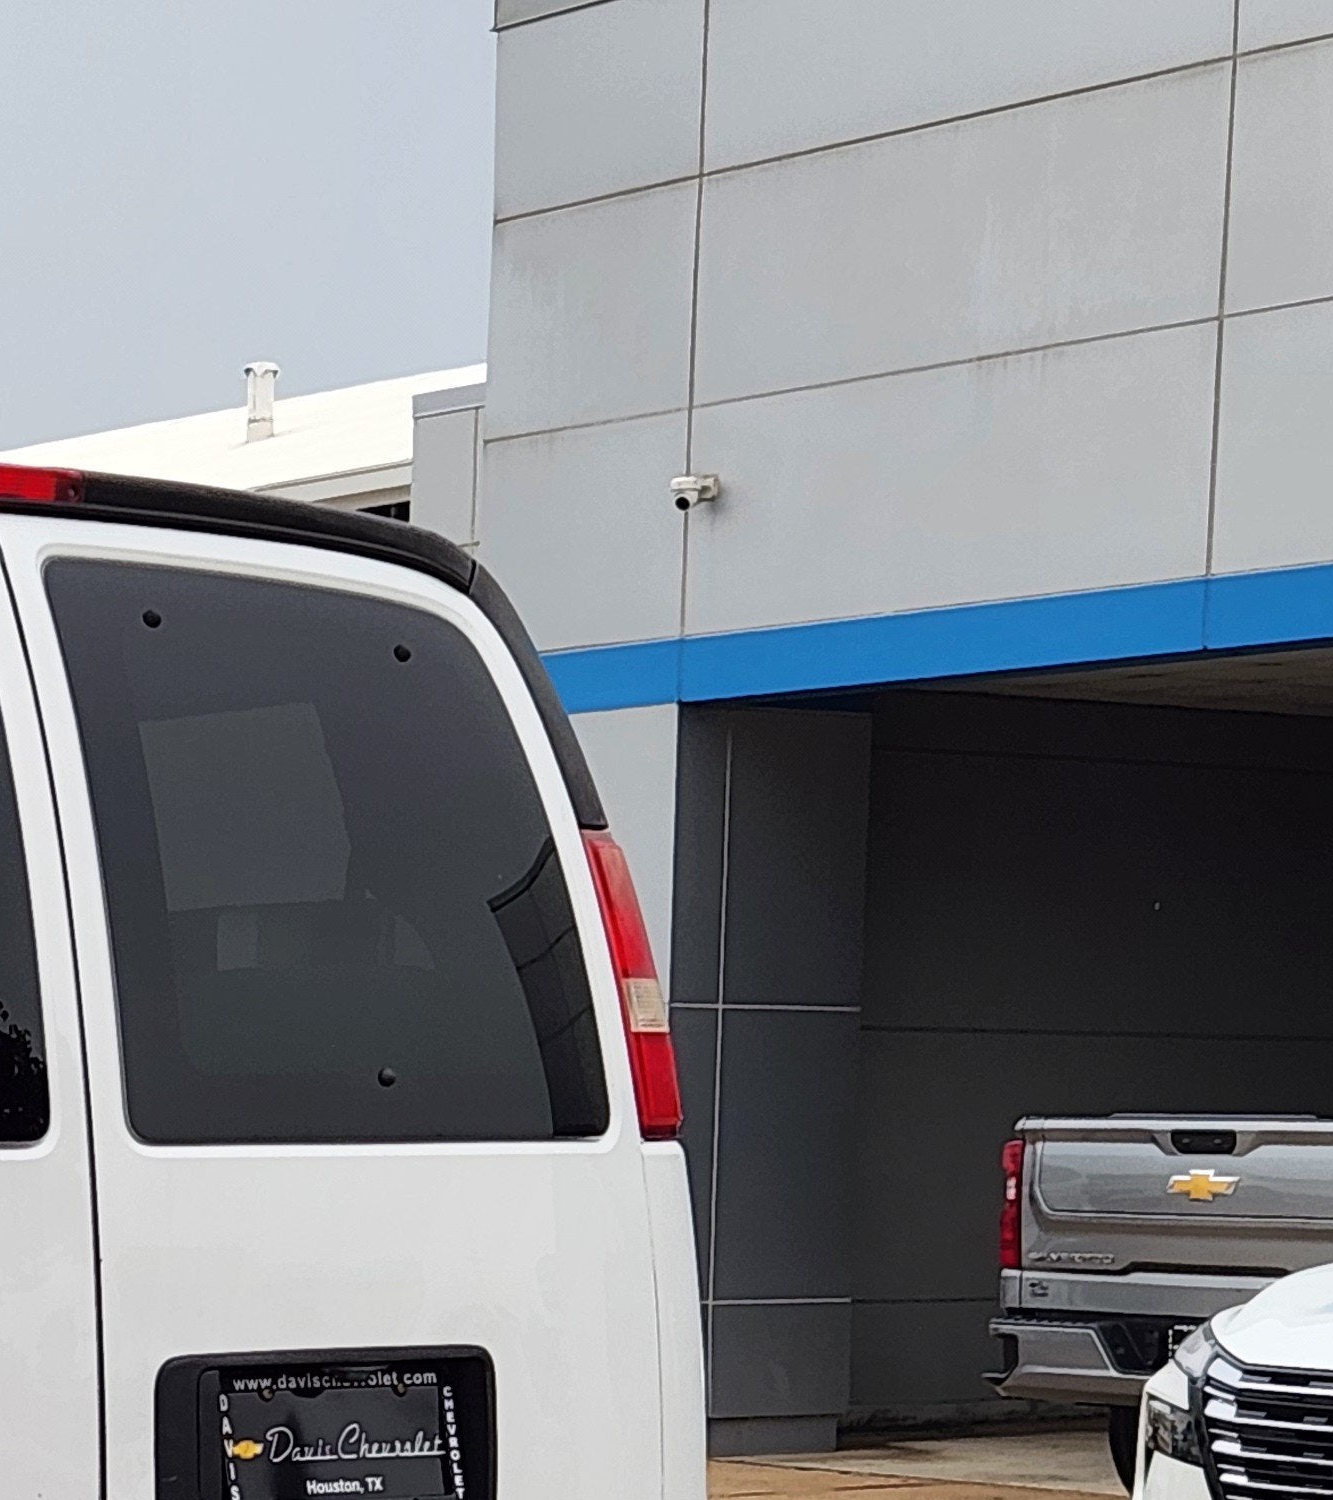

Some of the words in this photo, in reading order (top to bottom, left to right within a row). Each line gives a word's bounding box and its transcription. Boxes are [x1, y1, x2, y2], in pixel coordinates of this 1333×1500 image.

[233, 1371, 438, 1391] www.daviscoletcom
[265, 1426, 339, 1463] Davis
[337, 1422, 447, 1460] Chevrolet
[442, 1385, 466, 1500] CHEVROLET
[306, 1479, 365, 1495] Houston,
[365, 1476, 384, 1492] TX
